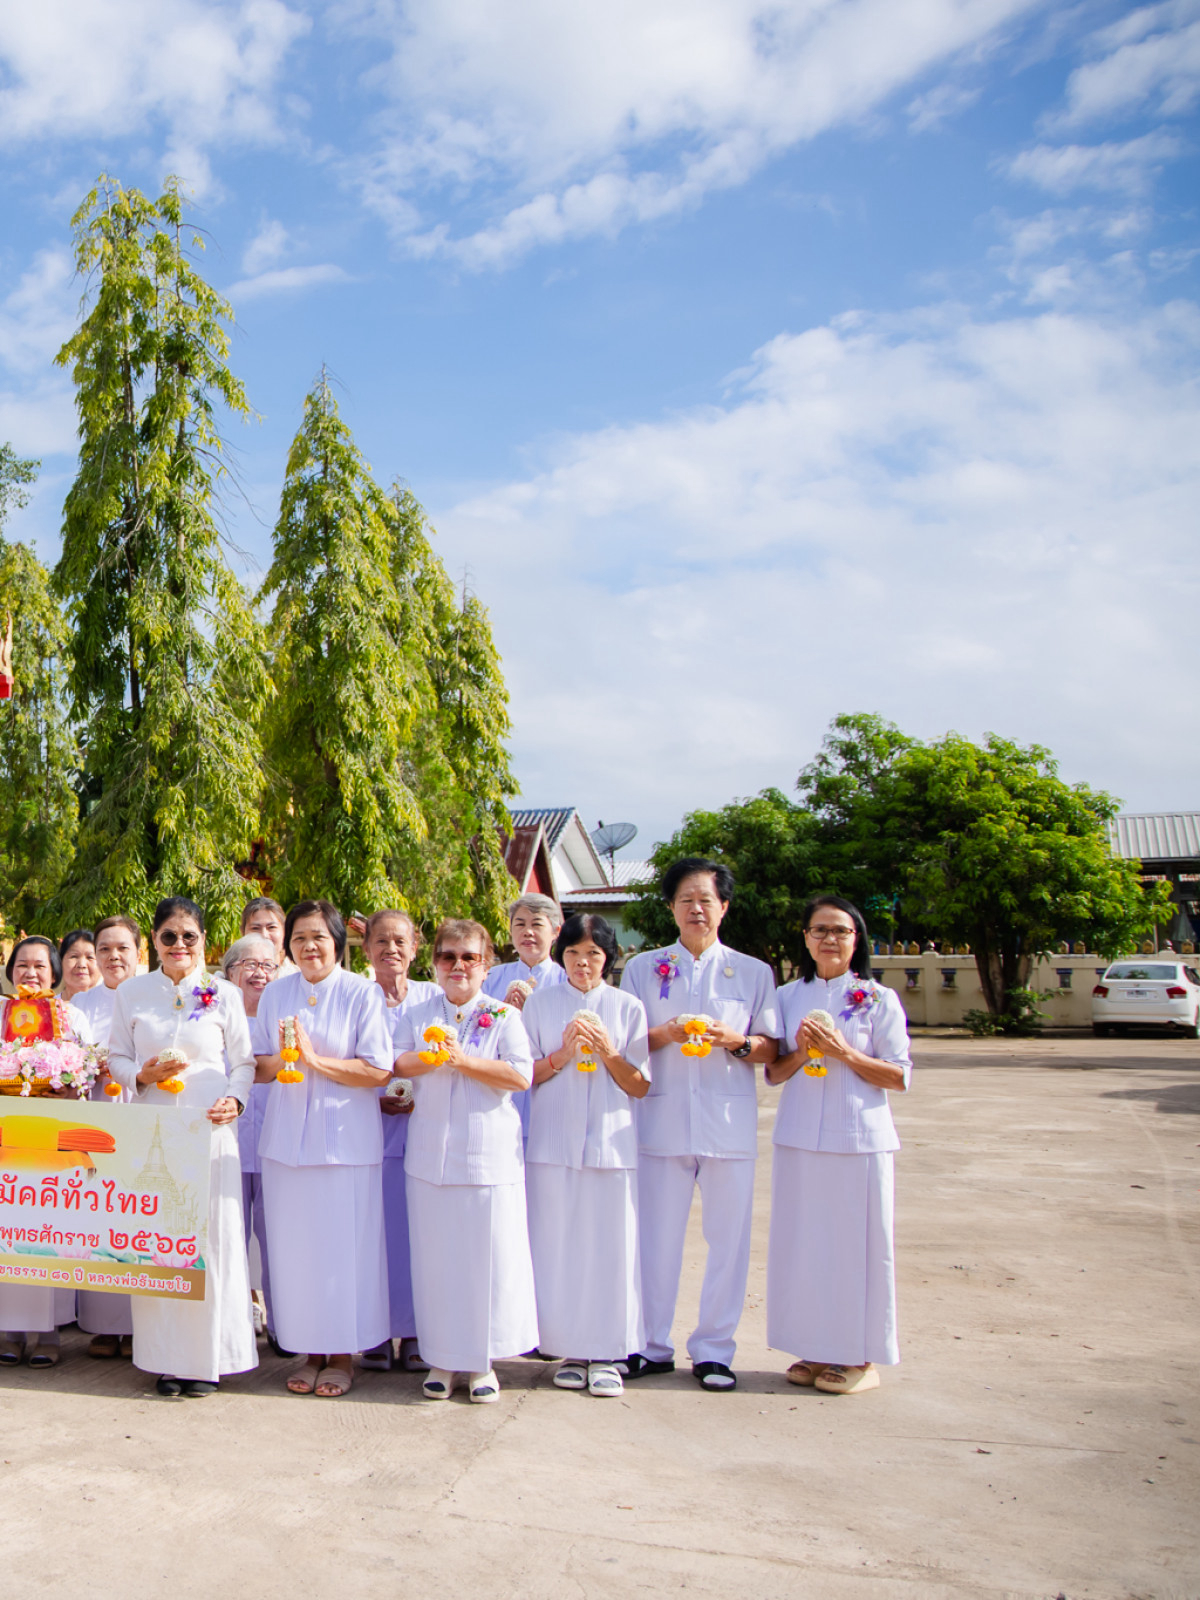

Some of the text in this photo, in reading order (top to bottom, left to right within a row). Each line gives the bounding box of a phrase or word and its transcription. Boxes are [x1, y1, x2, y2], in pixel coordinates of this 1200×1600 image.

[0, 1223, 100, 1248] พุทธศักราช
[108, 1228, 197, 1256] ๒๕๖๘
[52, 1270, 70, 1281] ๘๑
[74, 1267, 84, 1282] ปี
[88, 1272, 191, 1292] หลวงพ่อธัมมชโย
